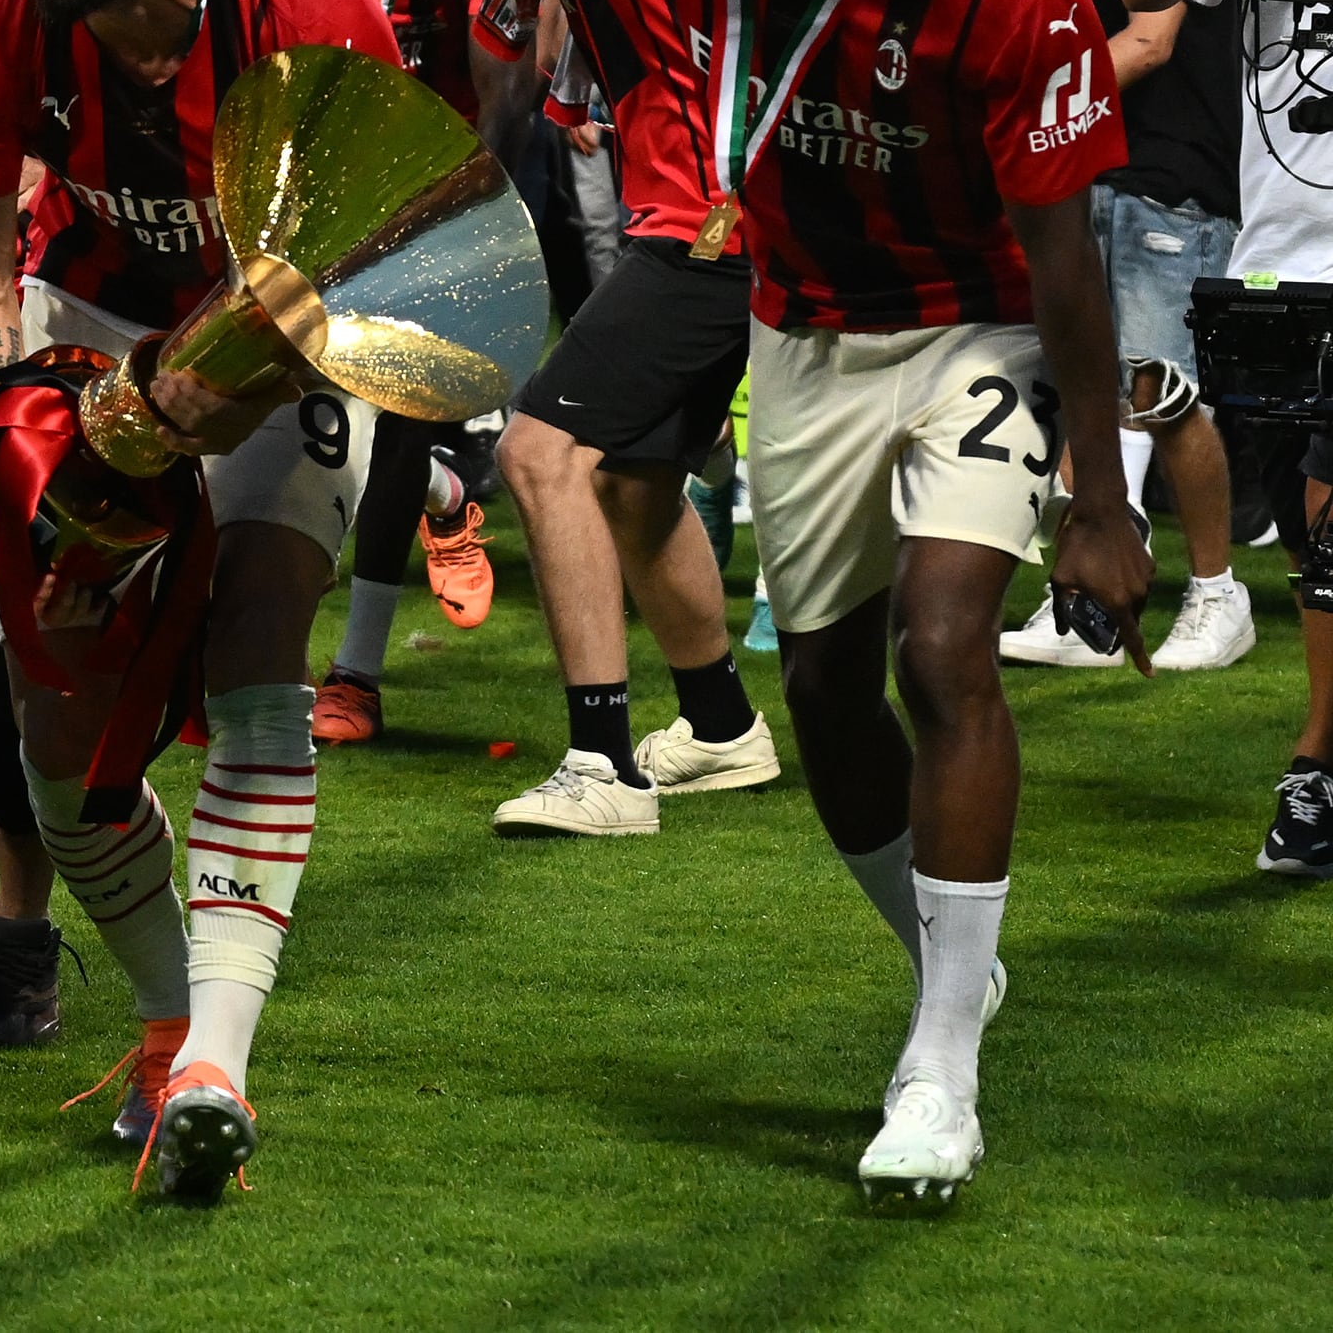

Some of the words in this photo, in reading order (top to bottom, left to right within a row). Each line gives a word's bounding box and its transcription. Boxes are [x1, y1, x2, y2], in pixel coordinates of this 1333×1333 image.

[779, 124, 891, 173] BETTER
[1028, 97, 1113, 154] BitMEX
[298, 392, 350, 469] 9
[198, 873, 261, 902] ACM
